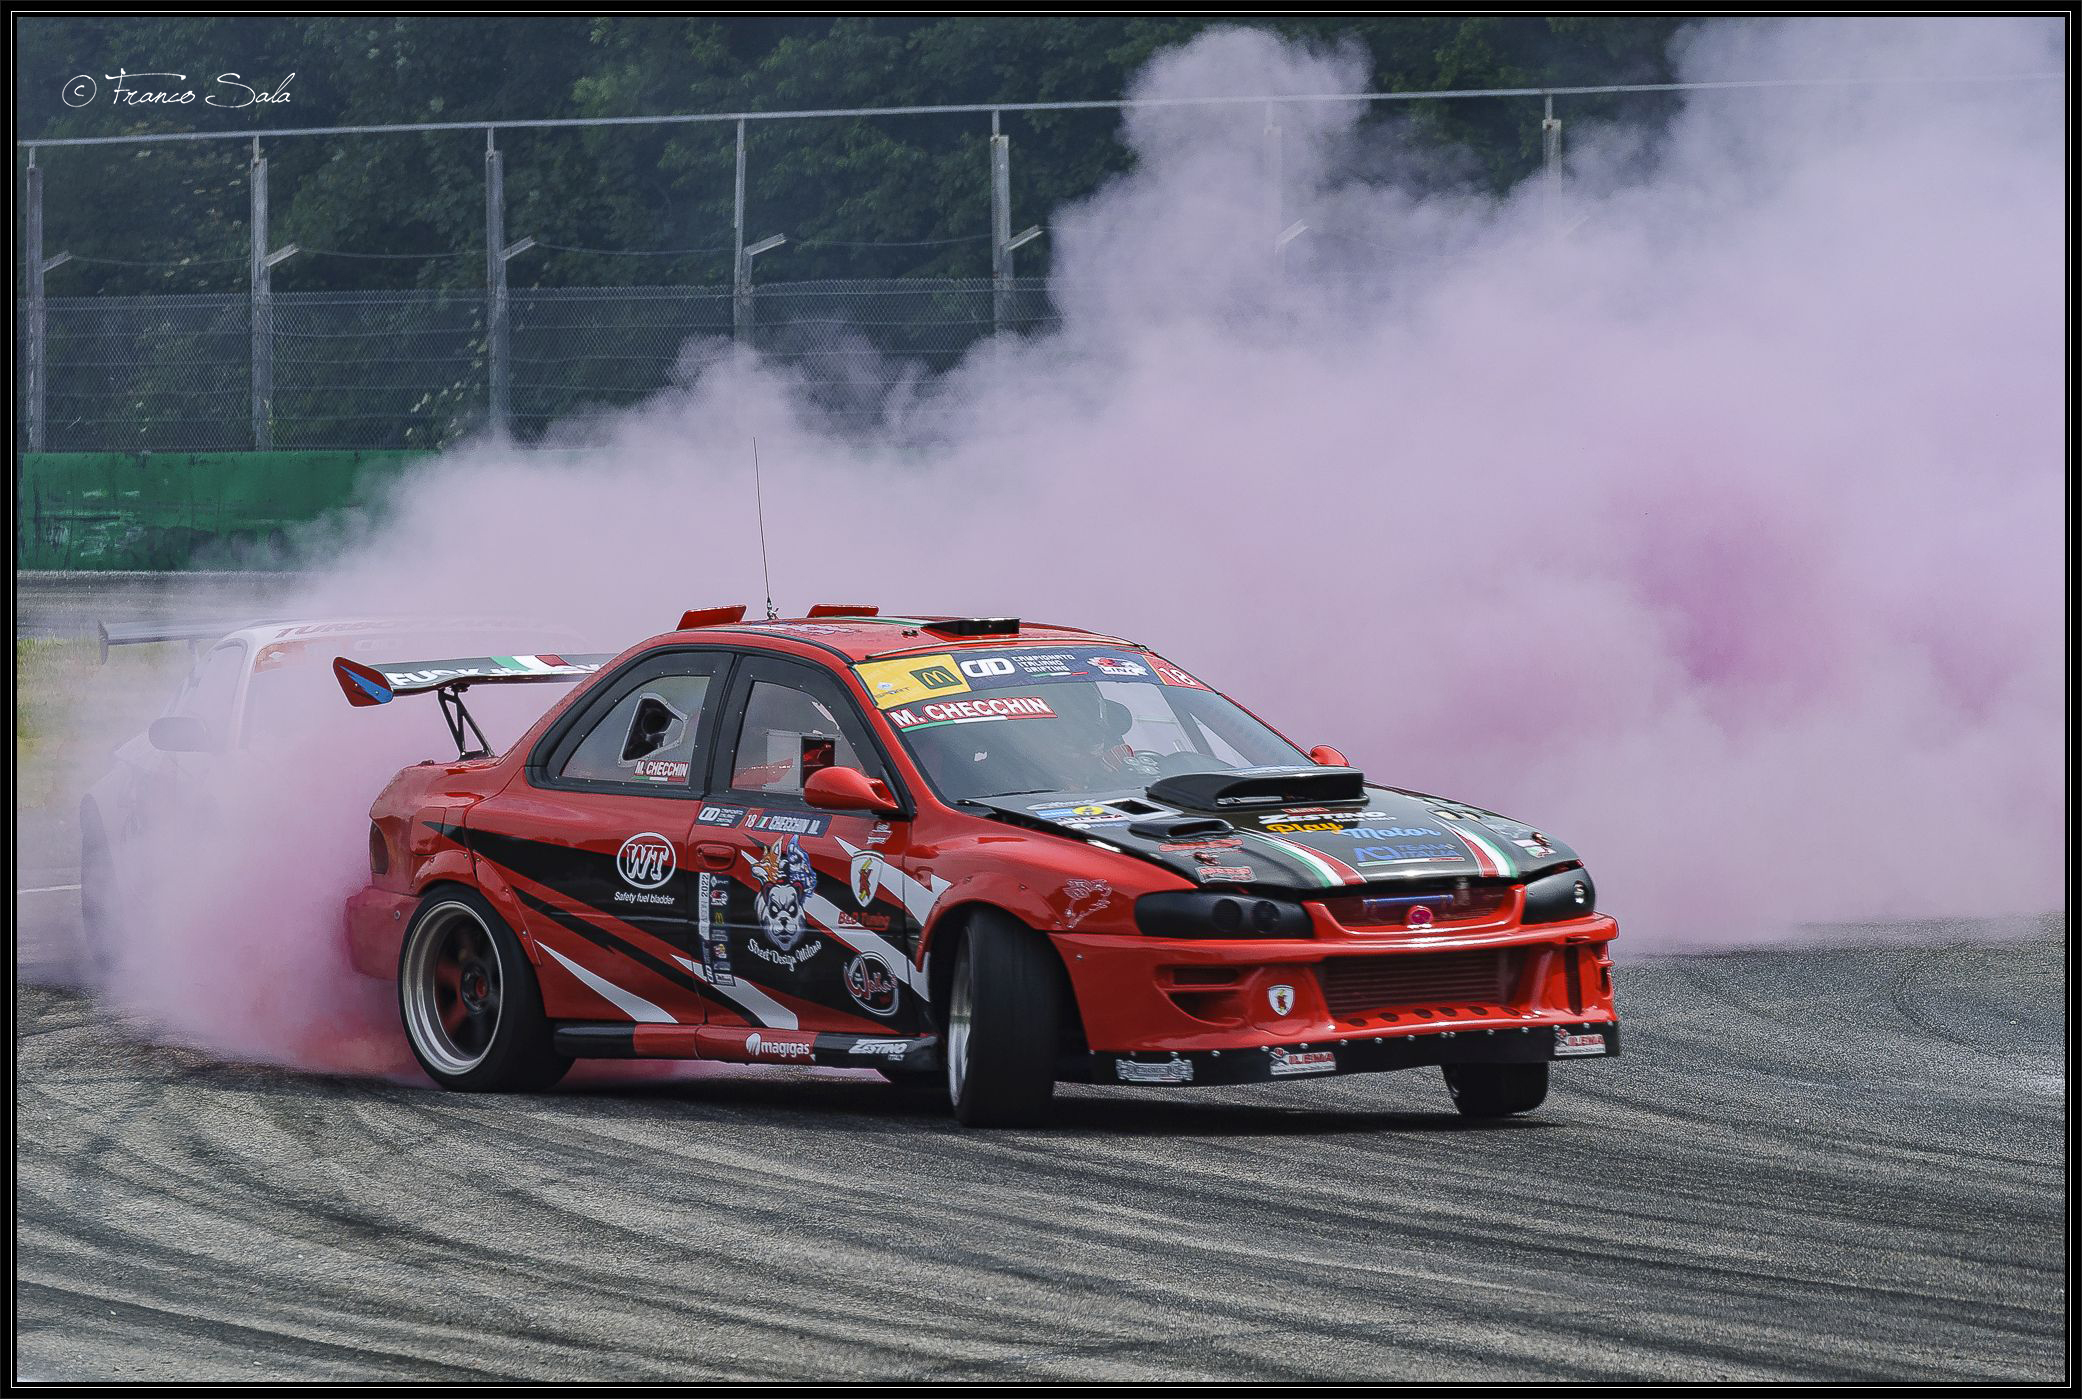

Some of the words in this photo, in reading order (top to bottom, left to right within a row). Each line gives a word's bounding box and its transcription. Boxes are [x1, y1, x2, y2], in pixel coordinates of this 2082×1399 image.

[1011, 654, 1075, 662] CAMPIONATO
[1024, 665, 1070, 673] DRIFTING
[1158, 667, 1196, 686] 18
[891, 710, 926, 727] M.
[926, 698, 1051, 720] CHECCHIN
[634, 761, 645, 775] M.
[646, 761, 688, 777] CHECCHIN
[745, 814, 757, 828] 18
[768, 815, 810, 834] CHECCHIN
[1259, 811, 1386, 824] ZESTINO
[1266, 822, 1343, 835] Play
[1337, 826, 1441, 840] Motor
[626, 844, 669, 881] WT
[701, 874, 710, 898] 2022
[614, 891, 636, 904] Safety
[637, 892, 650, 903] fuel
[650, 893, 675, 904] bladder
[748, 939, 770, 961] Street
[770, 950, 797, 972] Design
[796, 941, 822, 962] Milano
[760, 1041, 810, 1056] magigas
[849, 1039, 909, 1054] ZESTINO
